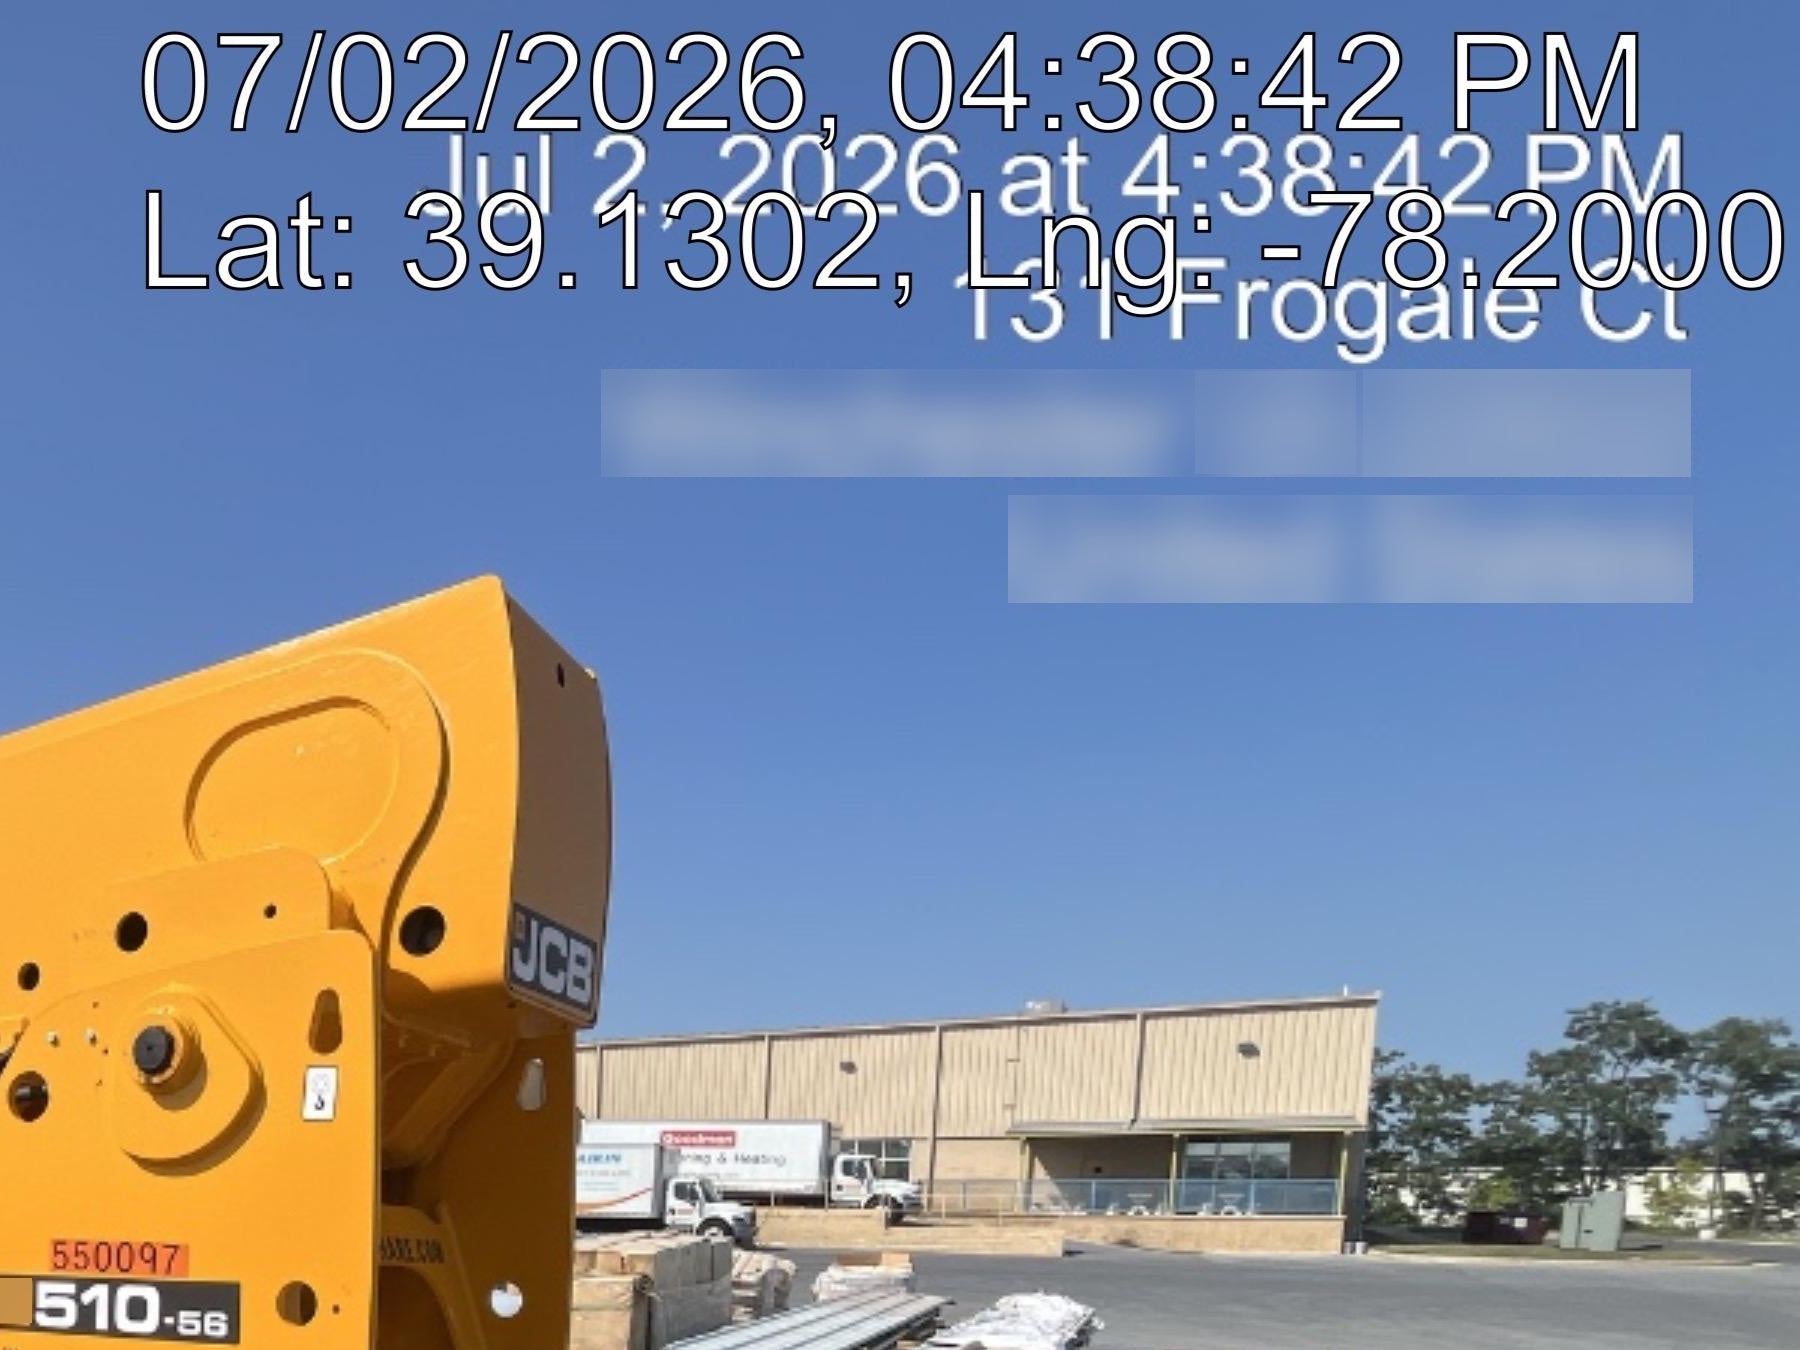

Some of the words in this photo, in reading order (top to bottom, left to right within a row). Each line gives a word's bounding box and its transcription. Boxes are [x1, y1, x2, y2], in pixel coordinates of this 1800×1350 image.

[512, 916, 594, 1005] JCB
[52, 1241, 181, 1275] 550097
[33, 1279, 229, 1338] 510-56
